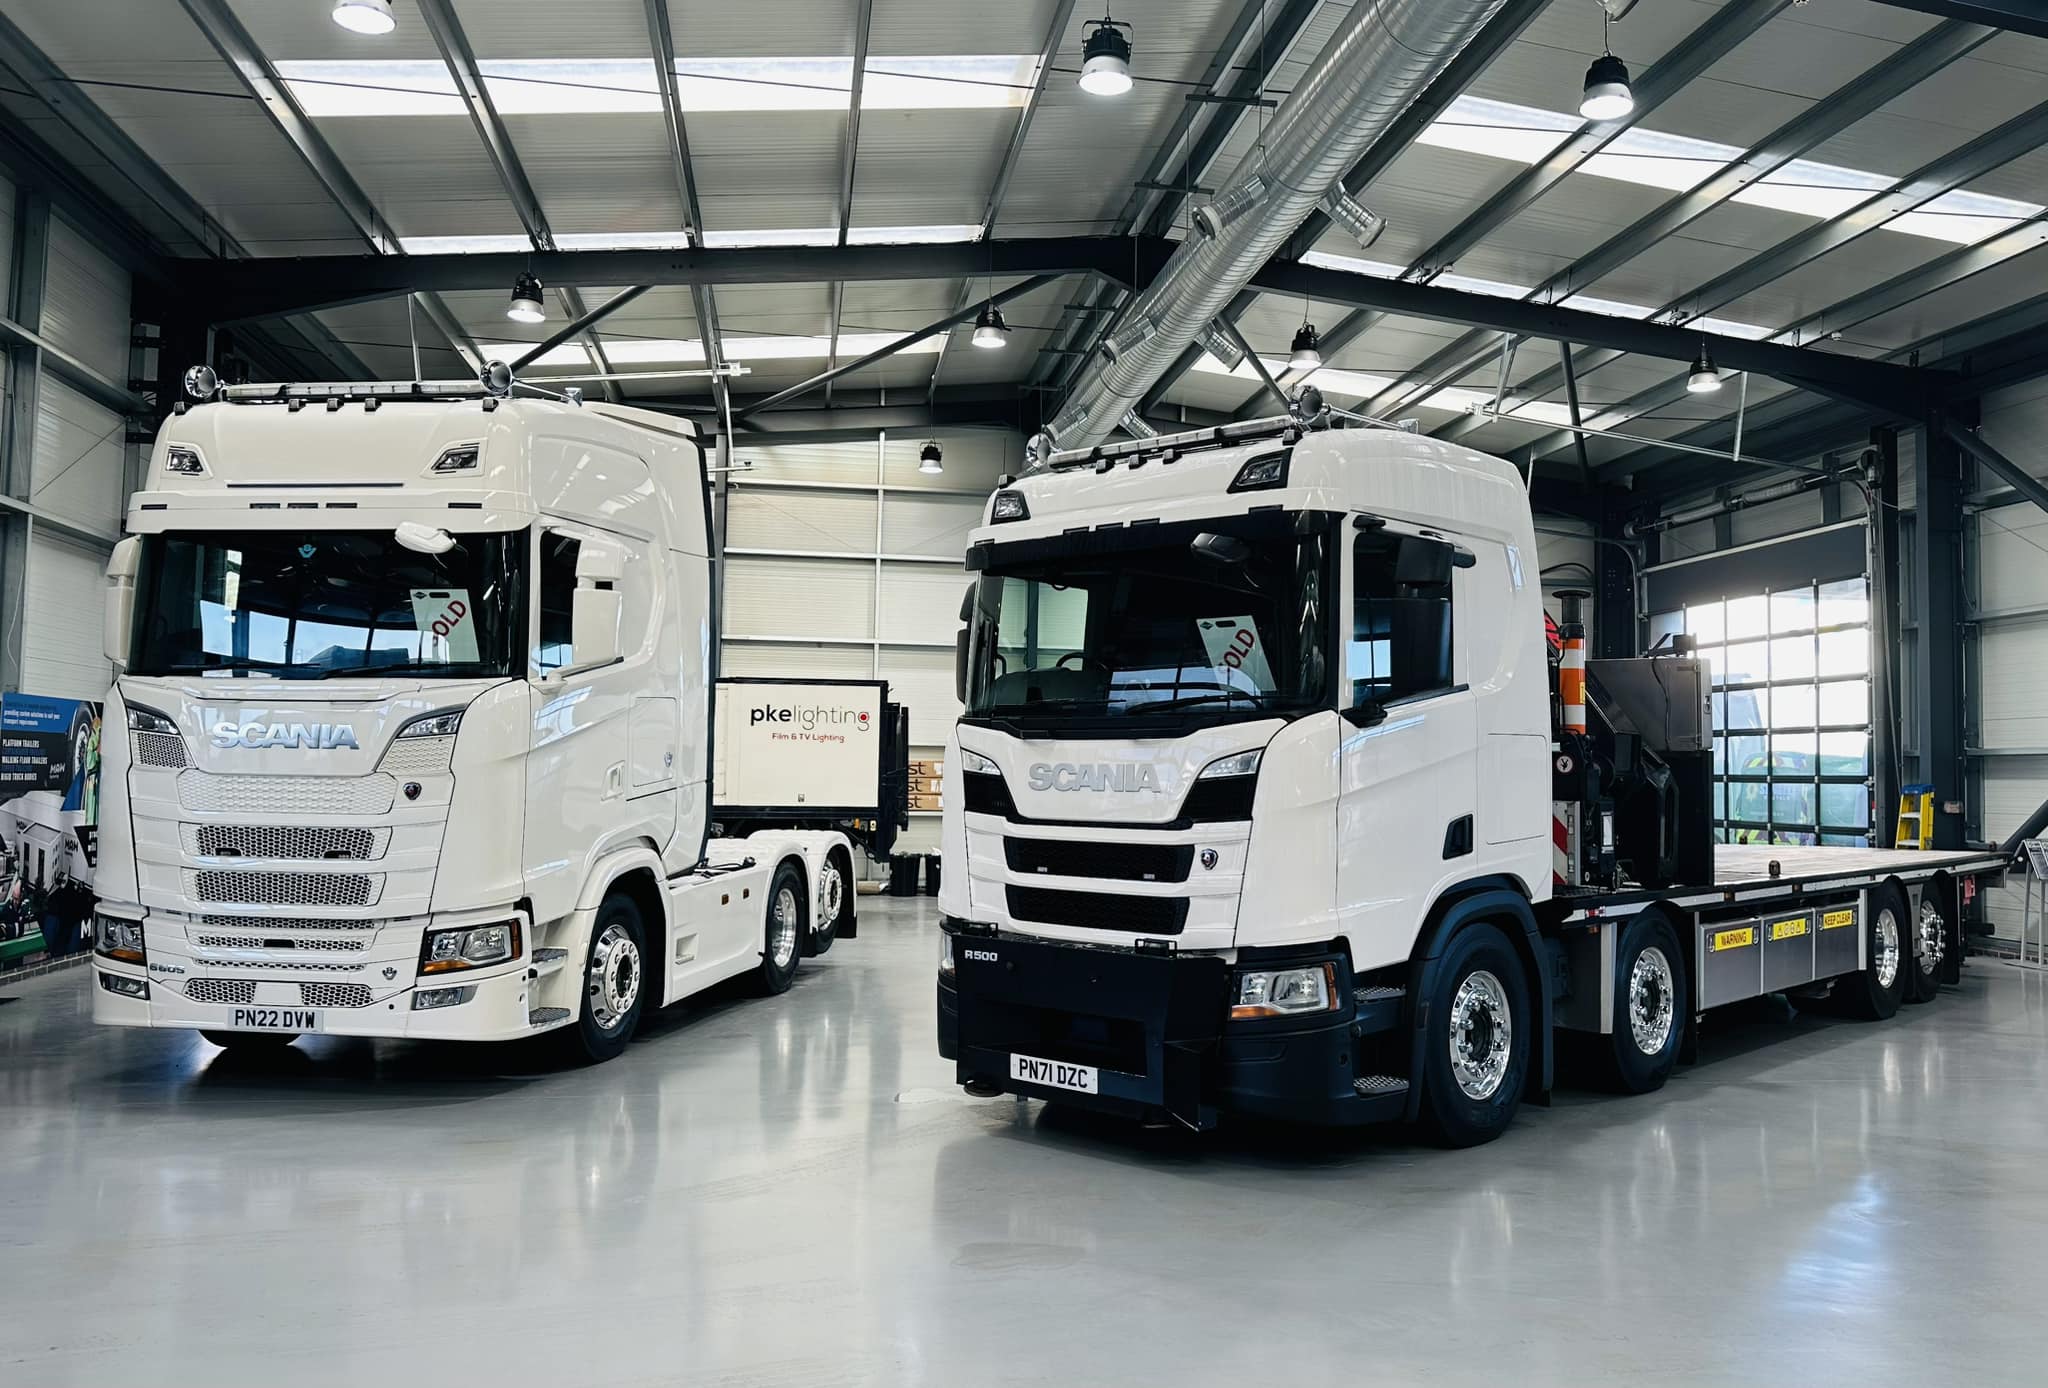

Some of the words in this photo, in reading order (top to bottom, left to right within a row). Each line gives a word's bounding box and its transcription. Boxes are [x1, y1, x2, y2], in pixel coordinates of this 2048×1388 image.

[1217, 629, 1255, 679] OLD
[210, 721, 360, 750] SCANIA
[812, 734, 845, 743] Lighting
[1028, 763, 1161, 793] SCANIA
[1824, 914, 1836, 926] KEEP
[1836, 912, 1851, 925] CLEAR
[1720, 930, 1747, 946] WARNING
[964, 949, 998, 962] R500
[235, 1009, 278, 1027] PN22
[283, 1011, 315, 1029] DVW
[1019, 1058, 1052, 1083] PN71
[1057, 1065, 1088, 1089] DZC
